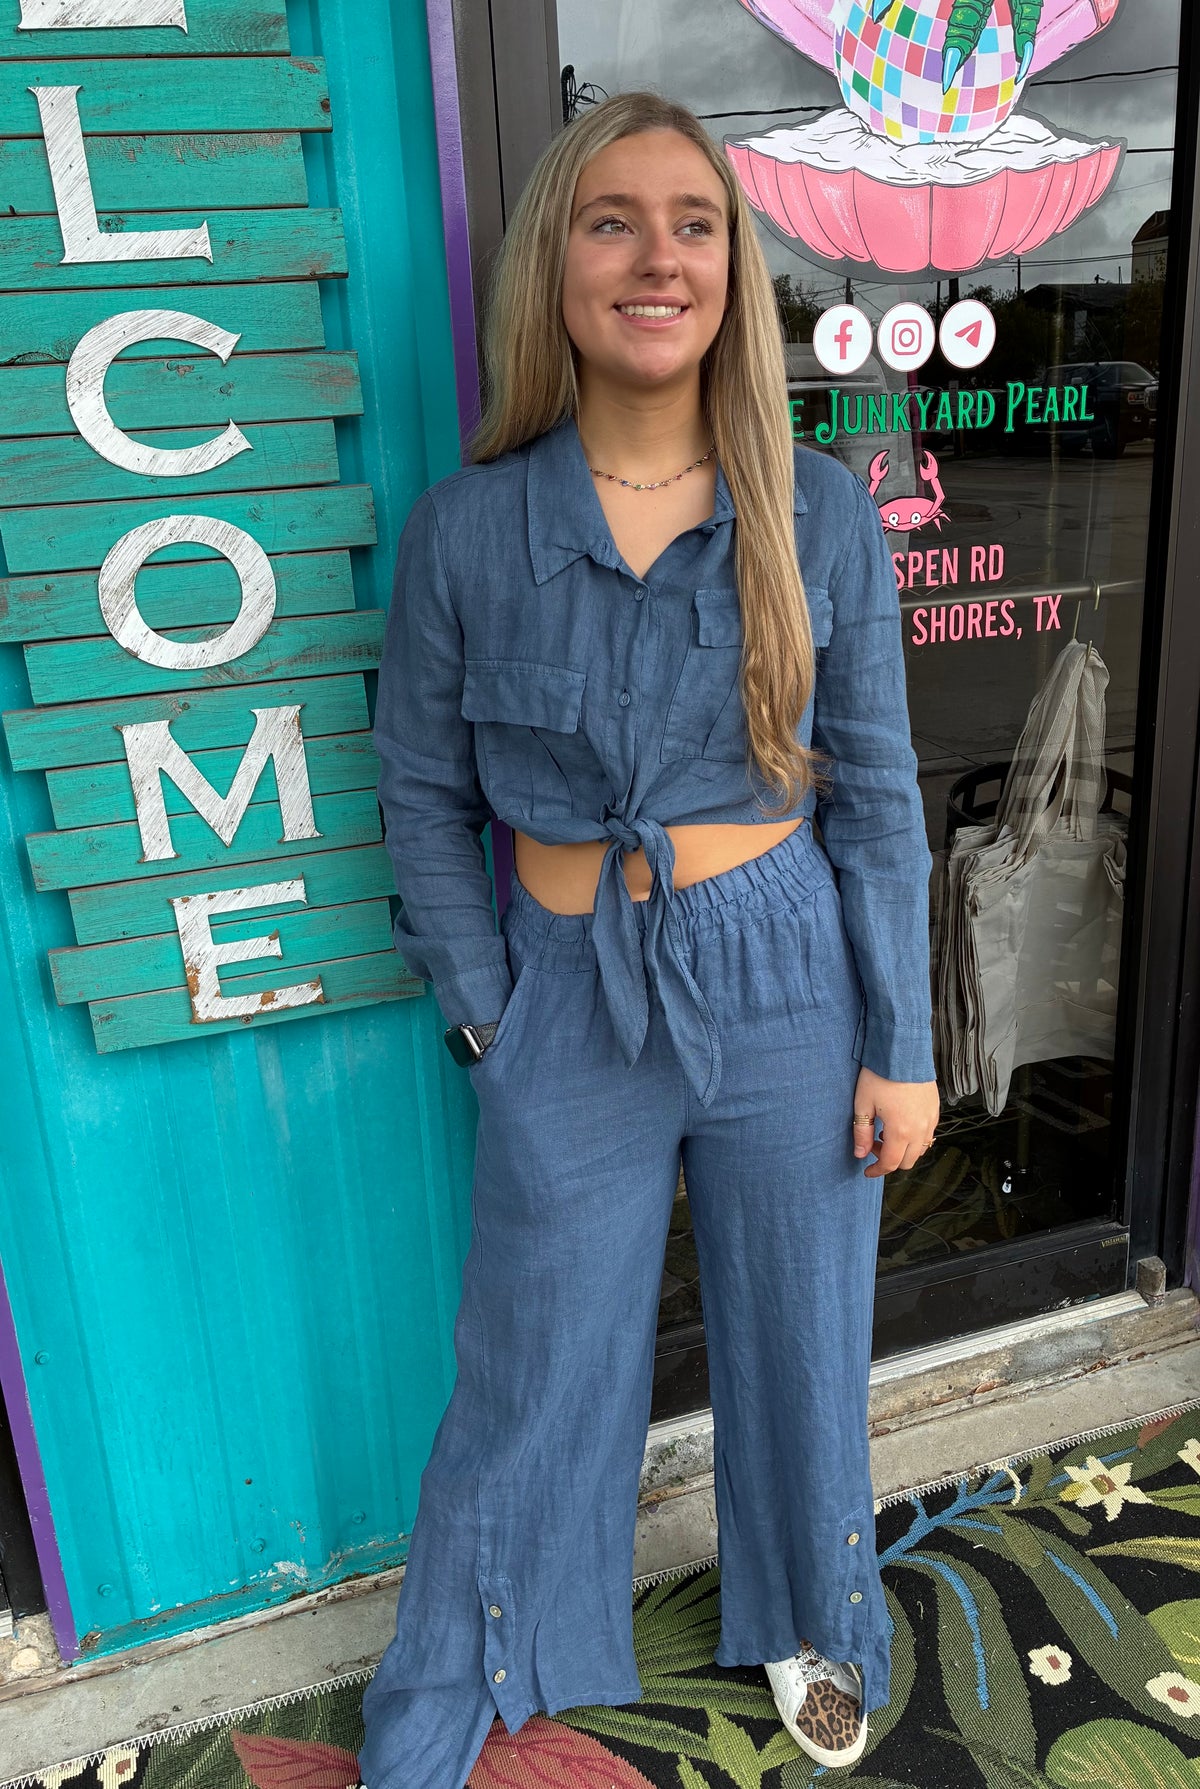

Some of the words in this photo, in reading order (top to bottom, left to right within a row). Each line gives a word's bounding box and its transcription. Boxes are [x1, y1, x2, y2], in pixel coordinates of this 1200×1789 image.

[815, 389, 996, 444] JUNKYARD
[1004, 381, 1095, 433] PEARL
[18, 0, 325, 1024] LCOME
[970, 544, 1004, 583] RD
[912, 599, 1023, 646] SHORES,
[1033, 594, 1063, 632] TX
